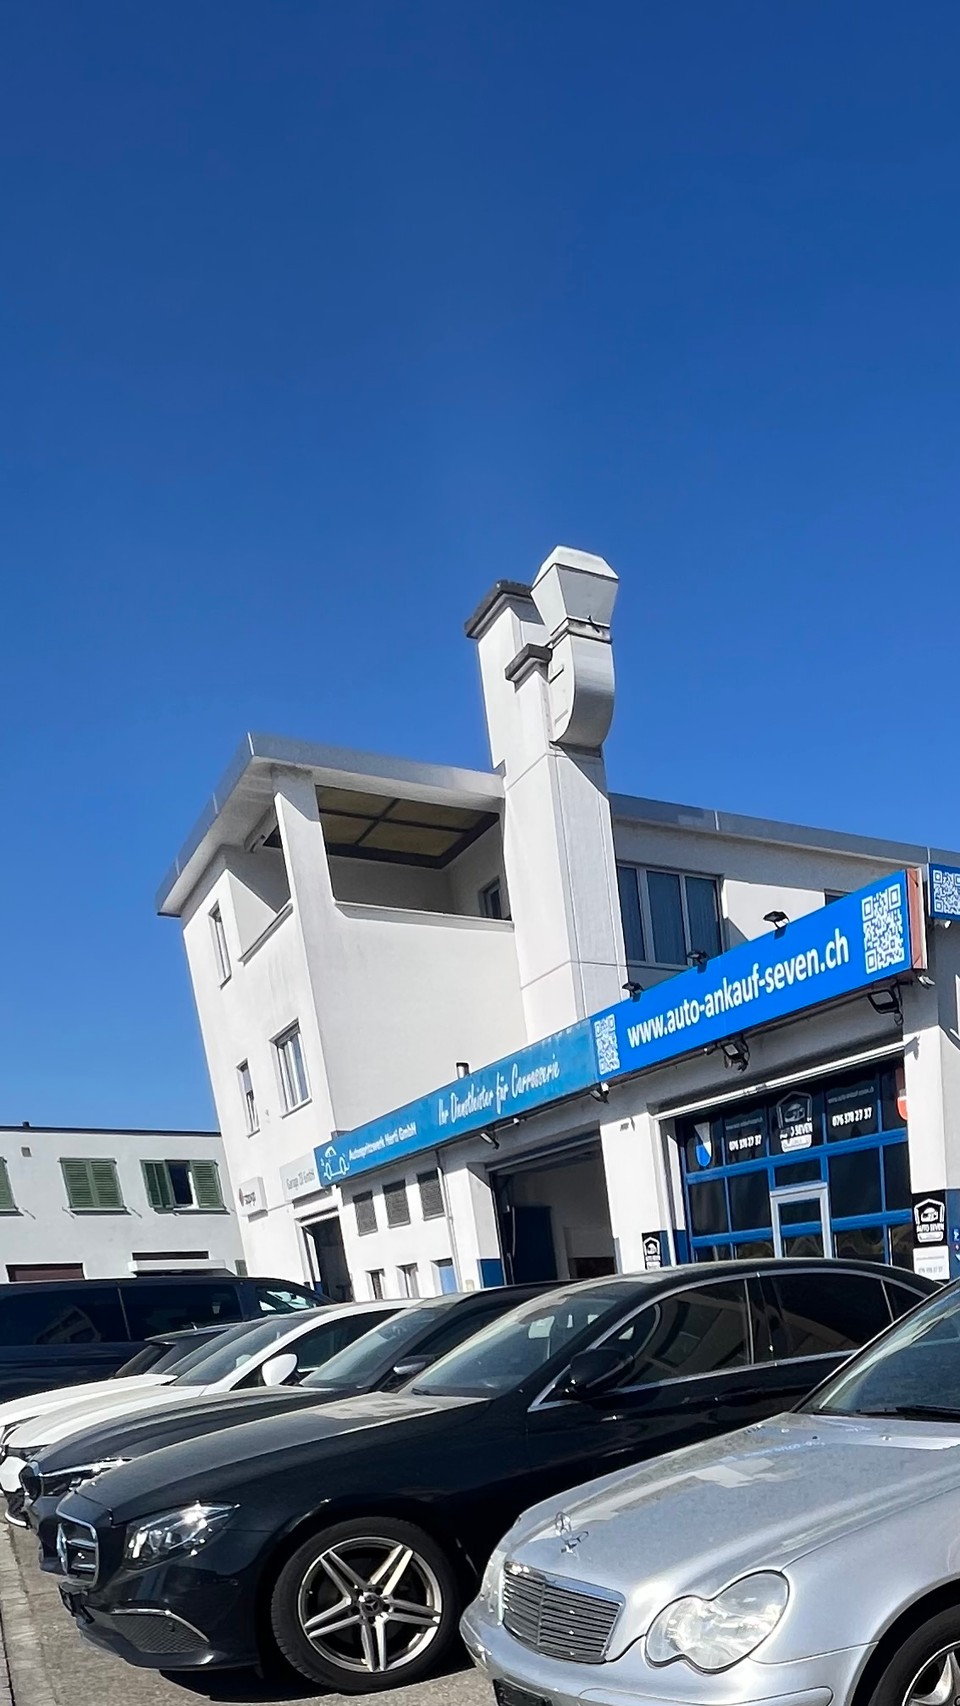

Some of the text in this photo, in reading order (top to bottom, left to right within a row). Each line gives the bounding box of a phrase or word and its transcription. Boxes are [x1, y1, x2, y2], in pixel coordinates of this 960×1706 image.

[627, 928, 849, 1048] www.auto-ankauf-seven.ch
[450, 1083, 494, 1123] Dienstleister
[496, 1072, 509, 1115] für
[511, 1054, 560, 1099] Carrosserie
[795, 1122, 813, 1136] SEVEN
